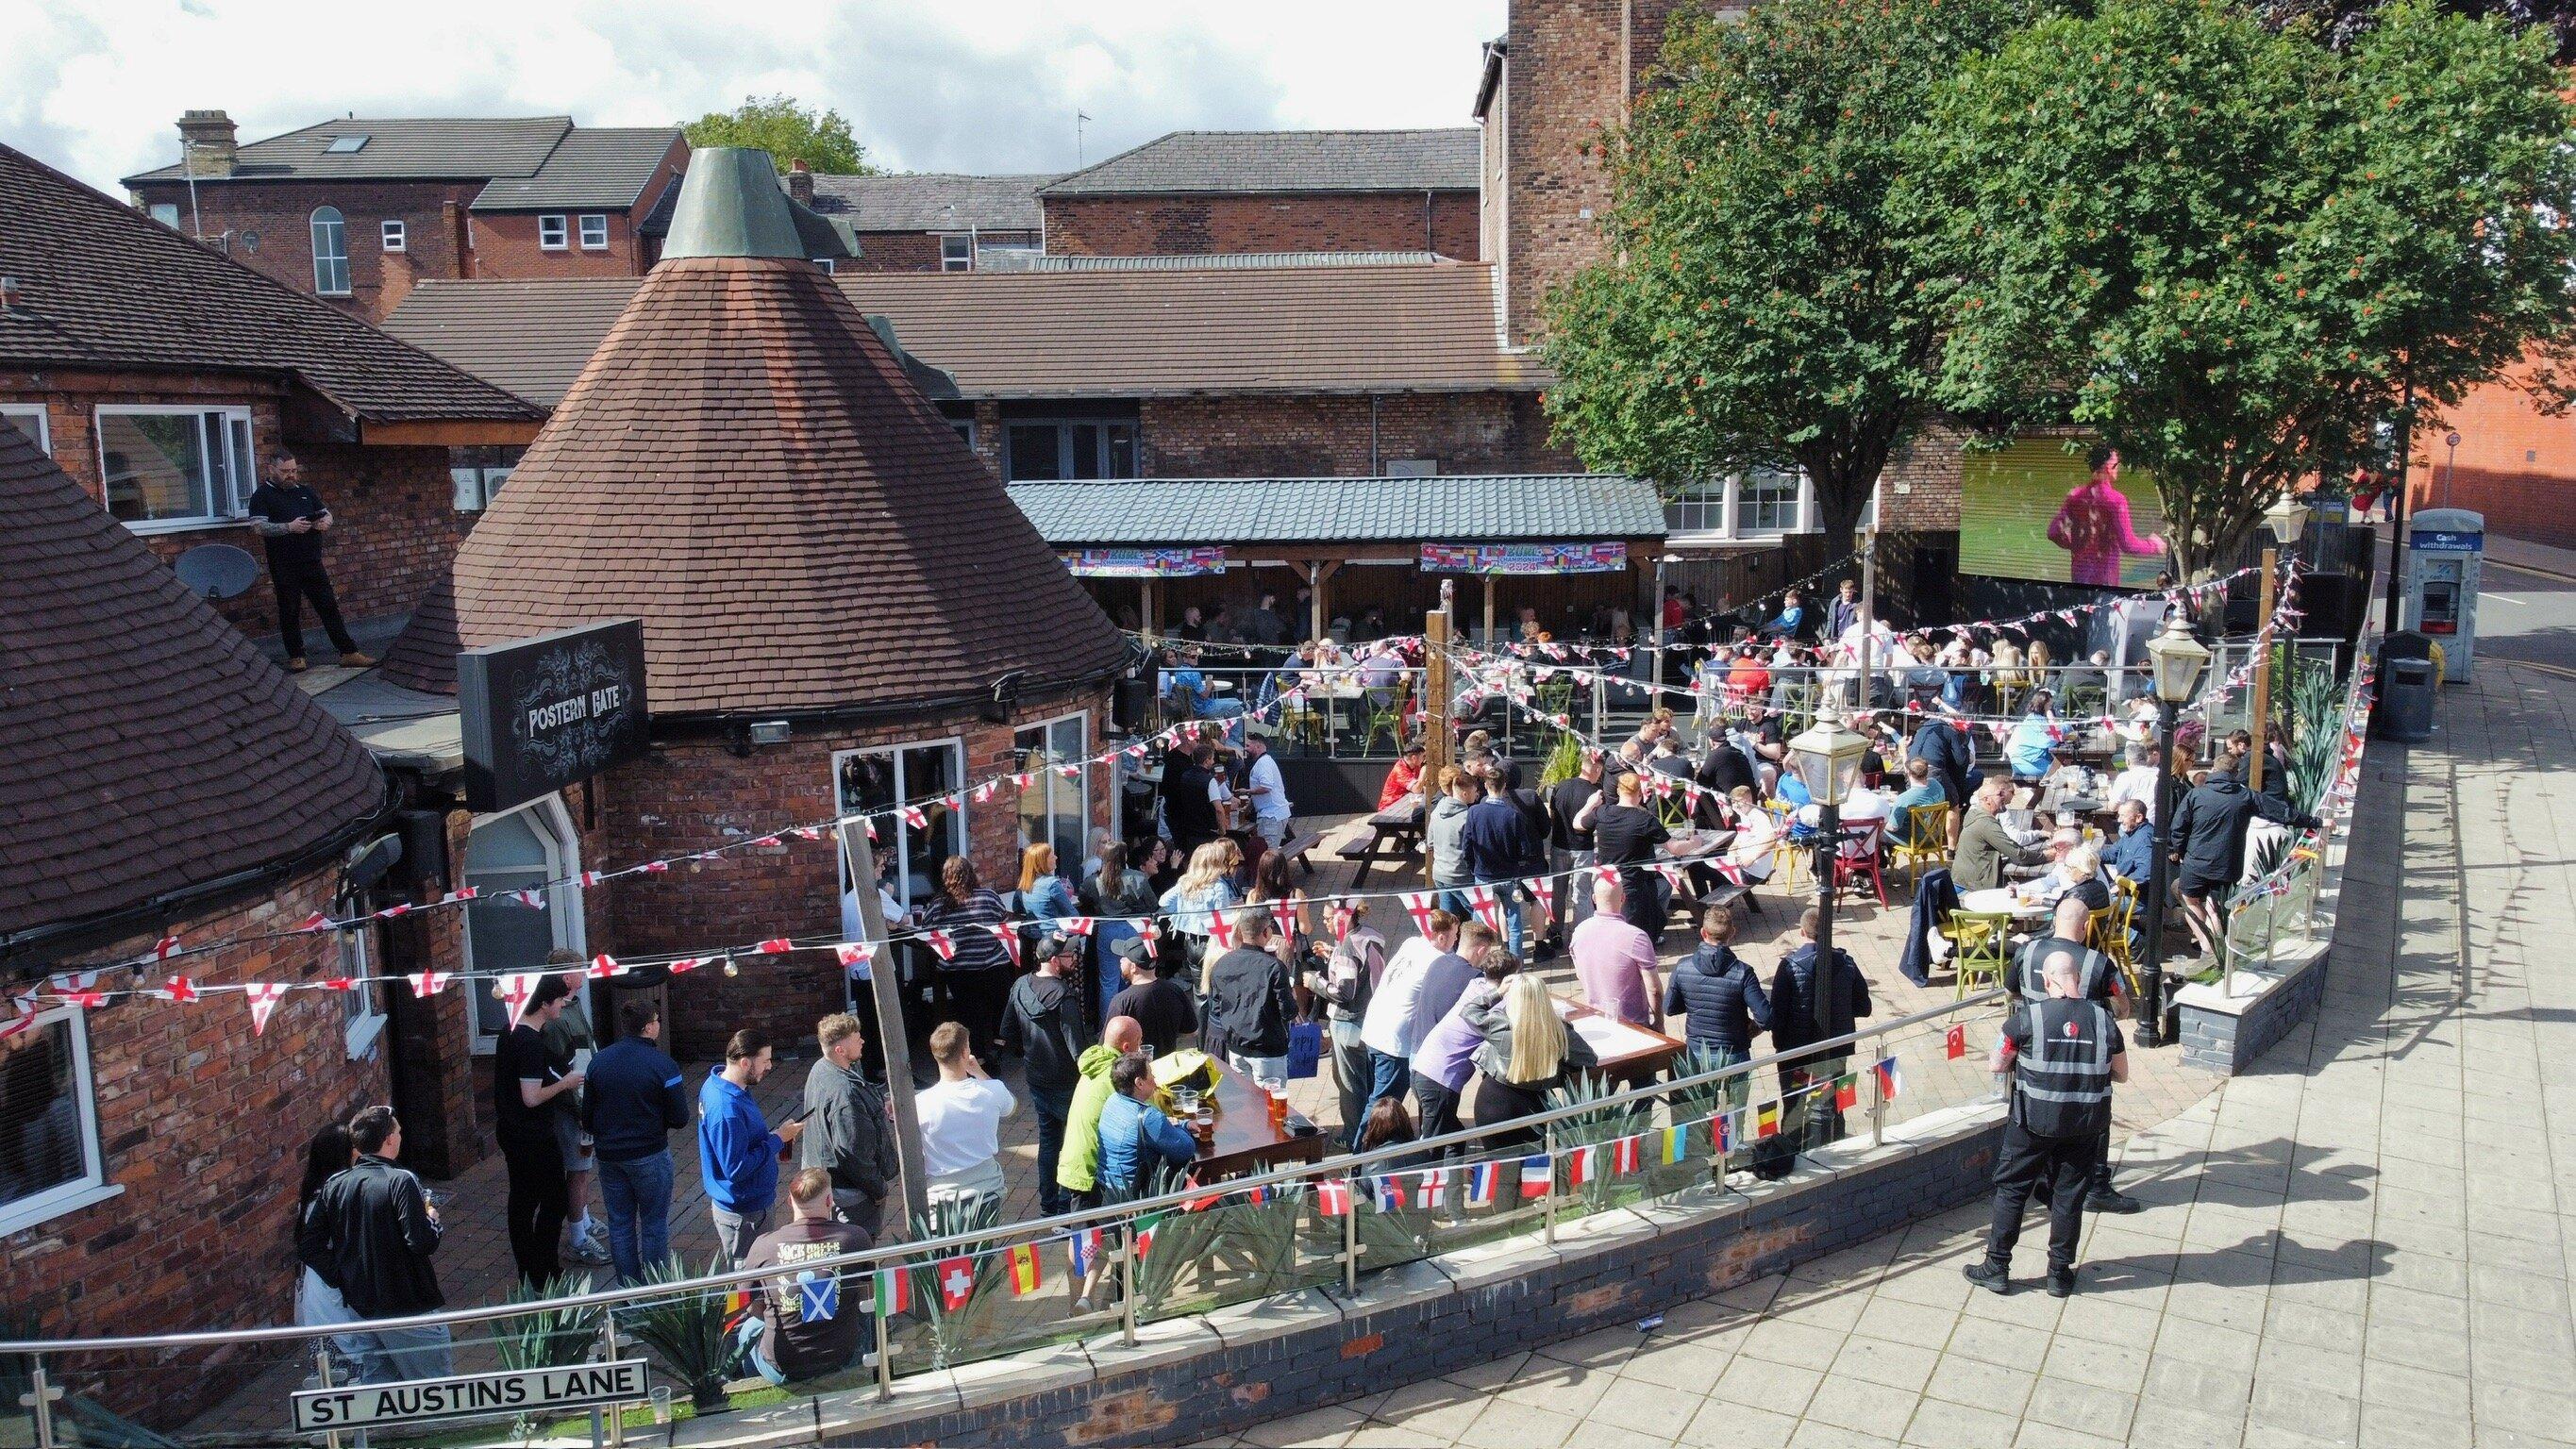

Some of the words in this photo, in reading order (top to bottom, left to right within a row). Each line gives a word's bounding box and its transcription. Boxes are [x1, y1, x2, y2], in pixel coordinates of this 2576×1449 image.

[2419, 541, 2472, 551] withdrawals
[1112, 566, 1138, 575] 2024
[1509, 562, 1536, 572] 2024
[528, 695, 587, 738] POSTERN
[592, 685, 620, 718] GATE
[310, 1394, 355, 1424] ST
[375, 1377, 527, 1418] AUSTINS
[544, 1367, 635, 1401] LANE
